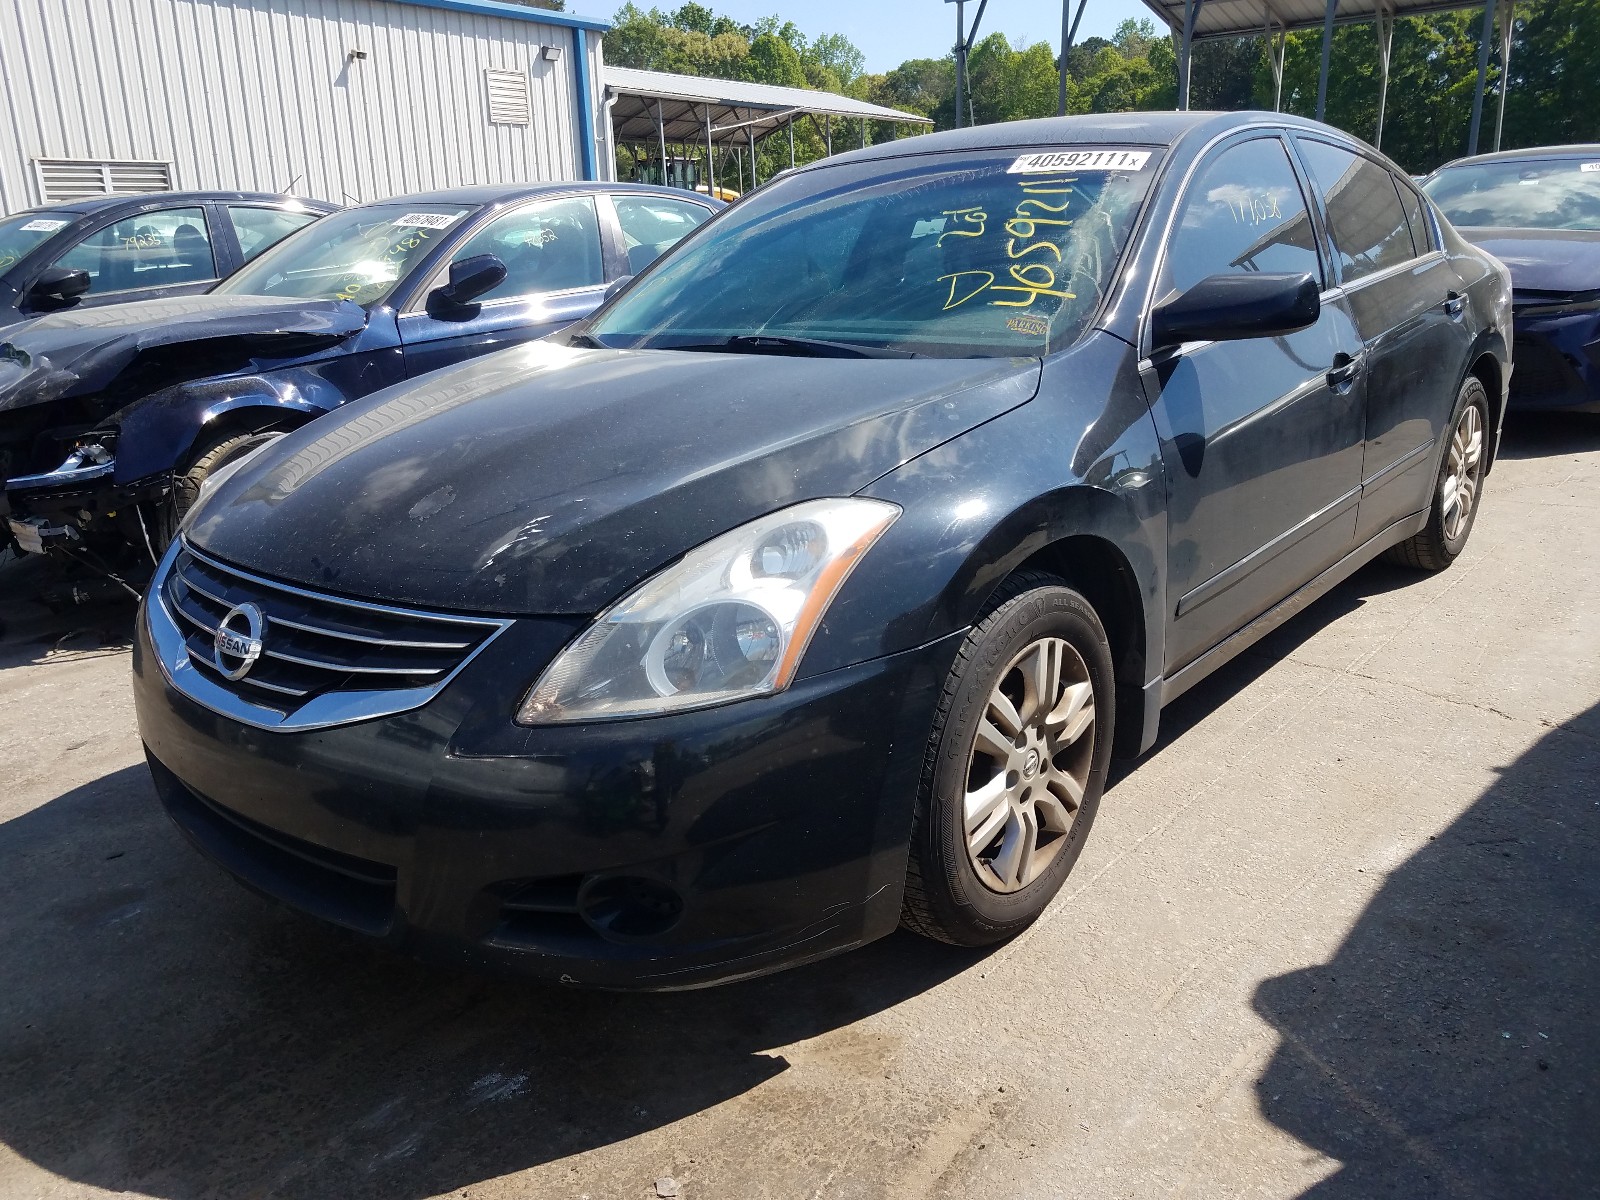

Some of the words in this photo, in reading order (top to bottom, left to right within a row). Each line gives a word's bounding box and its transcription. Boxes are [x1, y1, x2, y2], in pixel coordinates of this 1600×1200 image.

[1027, 152, 1129, 168] 40592111
[1006, 319, 1048, 335] PARKING
[1053, 598, 1068, 607] ALL
